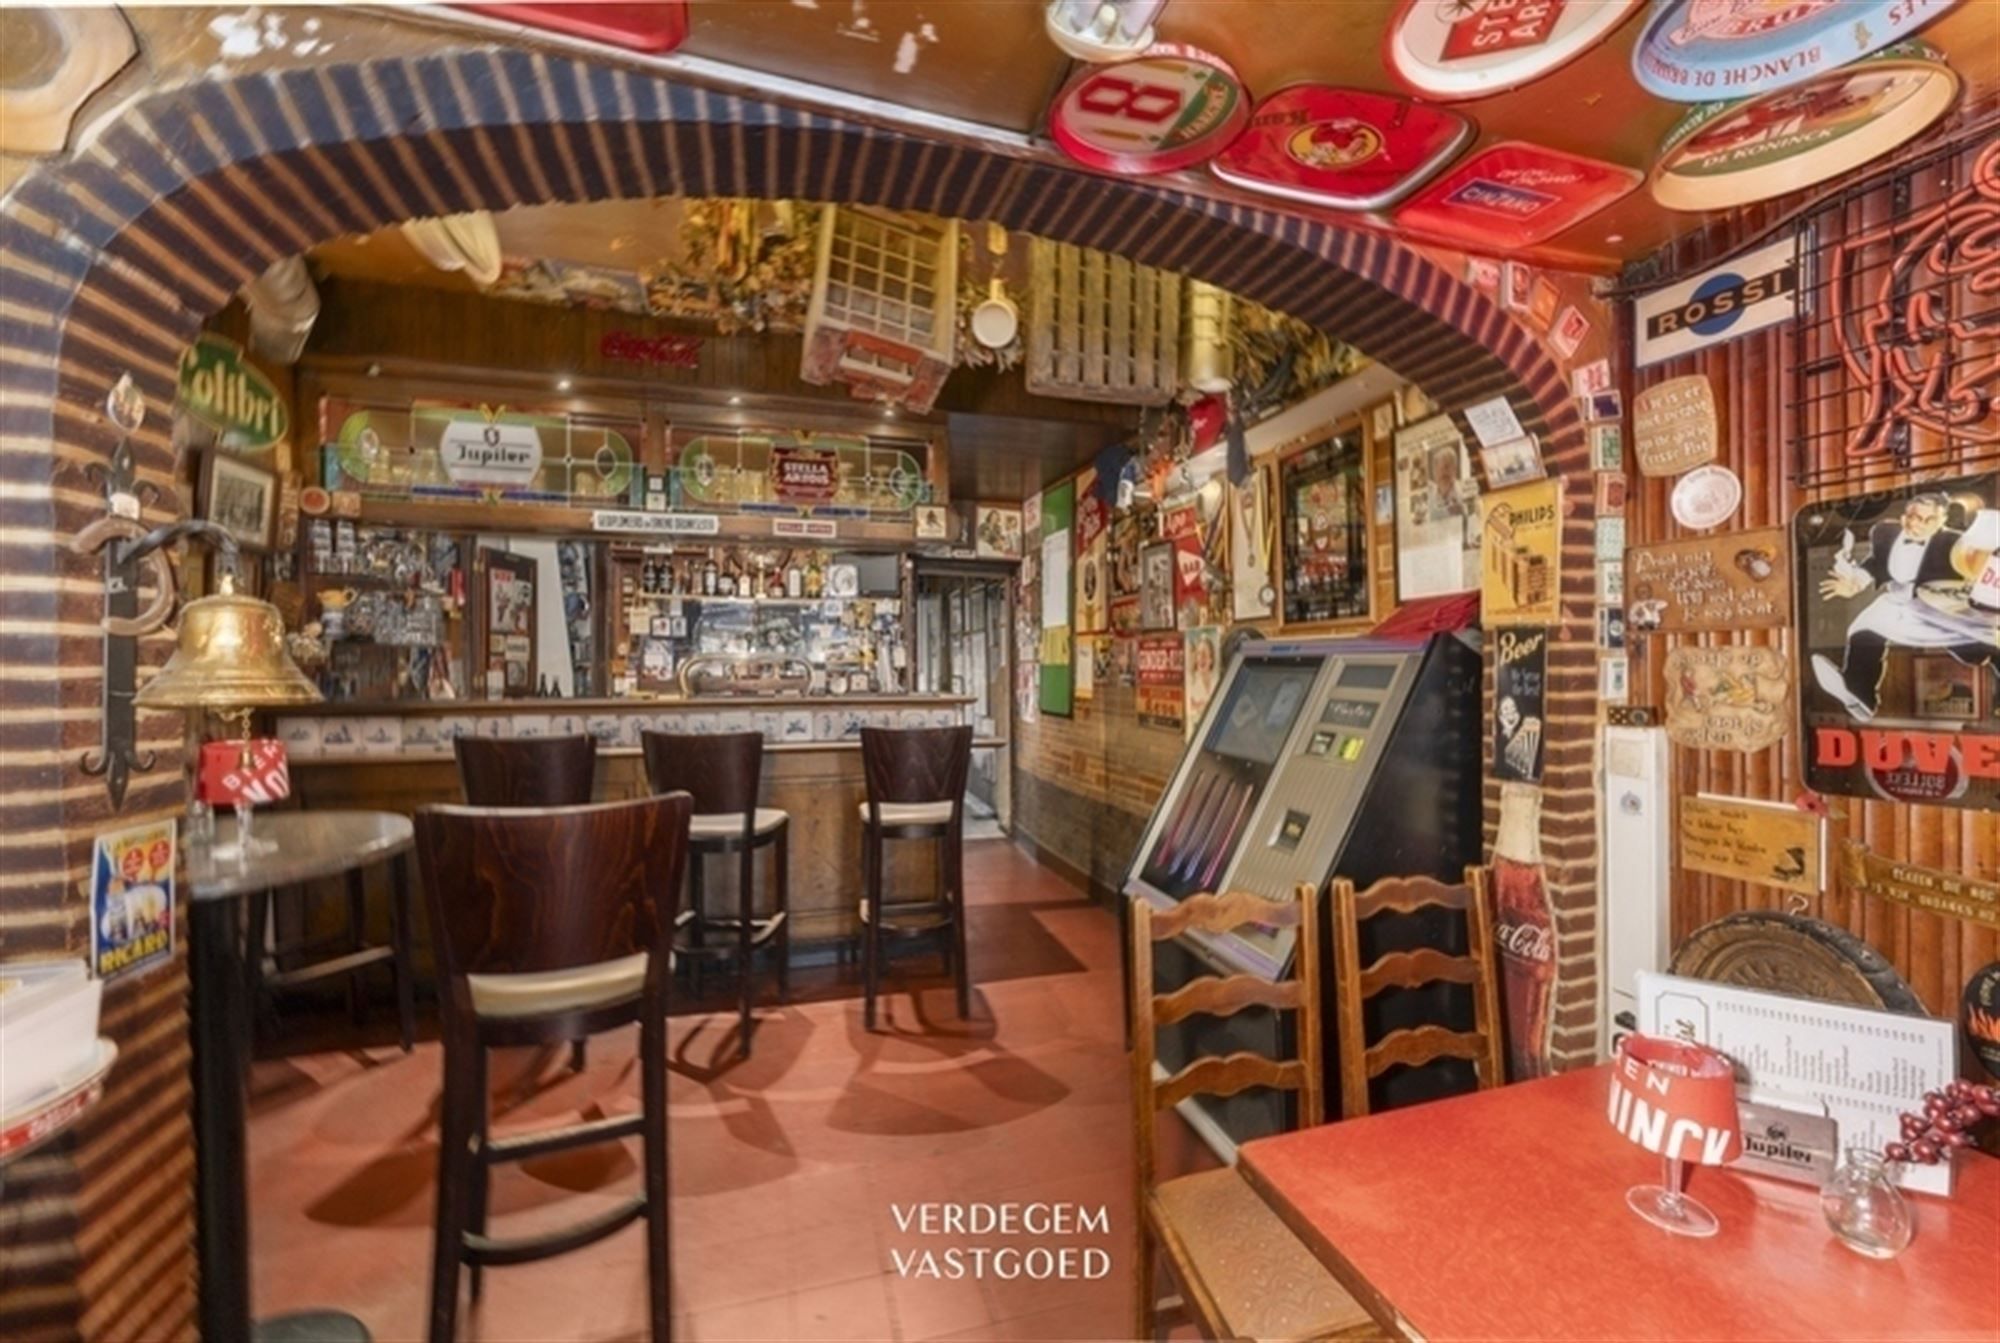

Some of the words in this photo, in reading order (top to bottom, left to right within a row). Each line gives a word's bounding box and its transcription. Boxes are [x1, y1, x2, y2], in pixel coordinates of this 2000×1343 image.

[1695, 70, 1716, 87] DE
[1722, 46, 1822, 86] BLANCHE
[1078, 75, 1181, 126] 8
[1702, 152, 1729, 168] DE
[1734, 127, 1835, 159] KONINCK
[1656, 274, 1783, 335] ROSSI
[458, 443, 531, 468] Jupiler
[783, 462, 828, 473] STELLA
[1508, 504, 1556, 526] PHILIPS
[1500, 632, 1543, 666] Beer
[99, 928, 169, 975] RICARD
[1745, 1136, 1812, 1164] Jupiler
